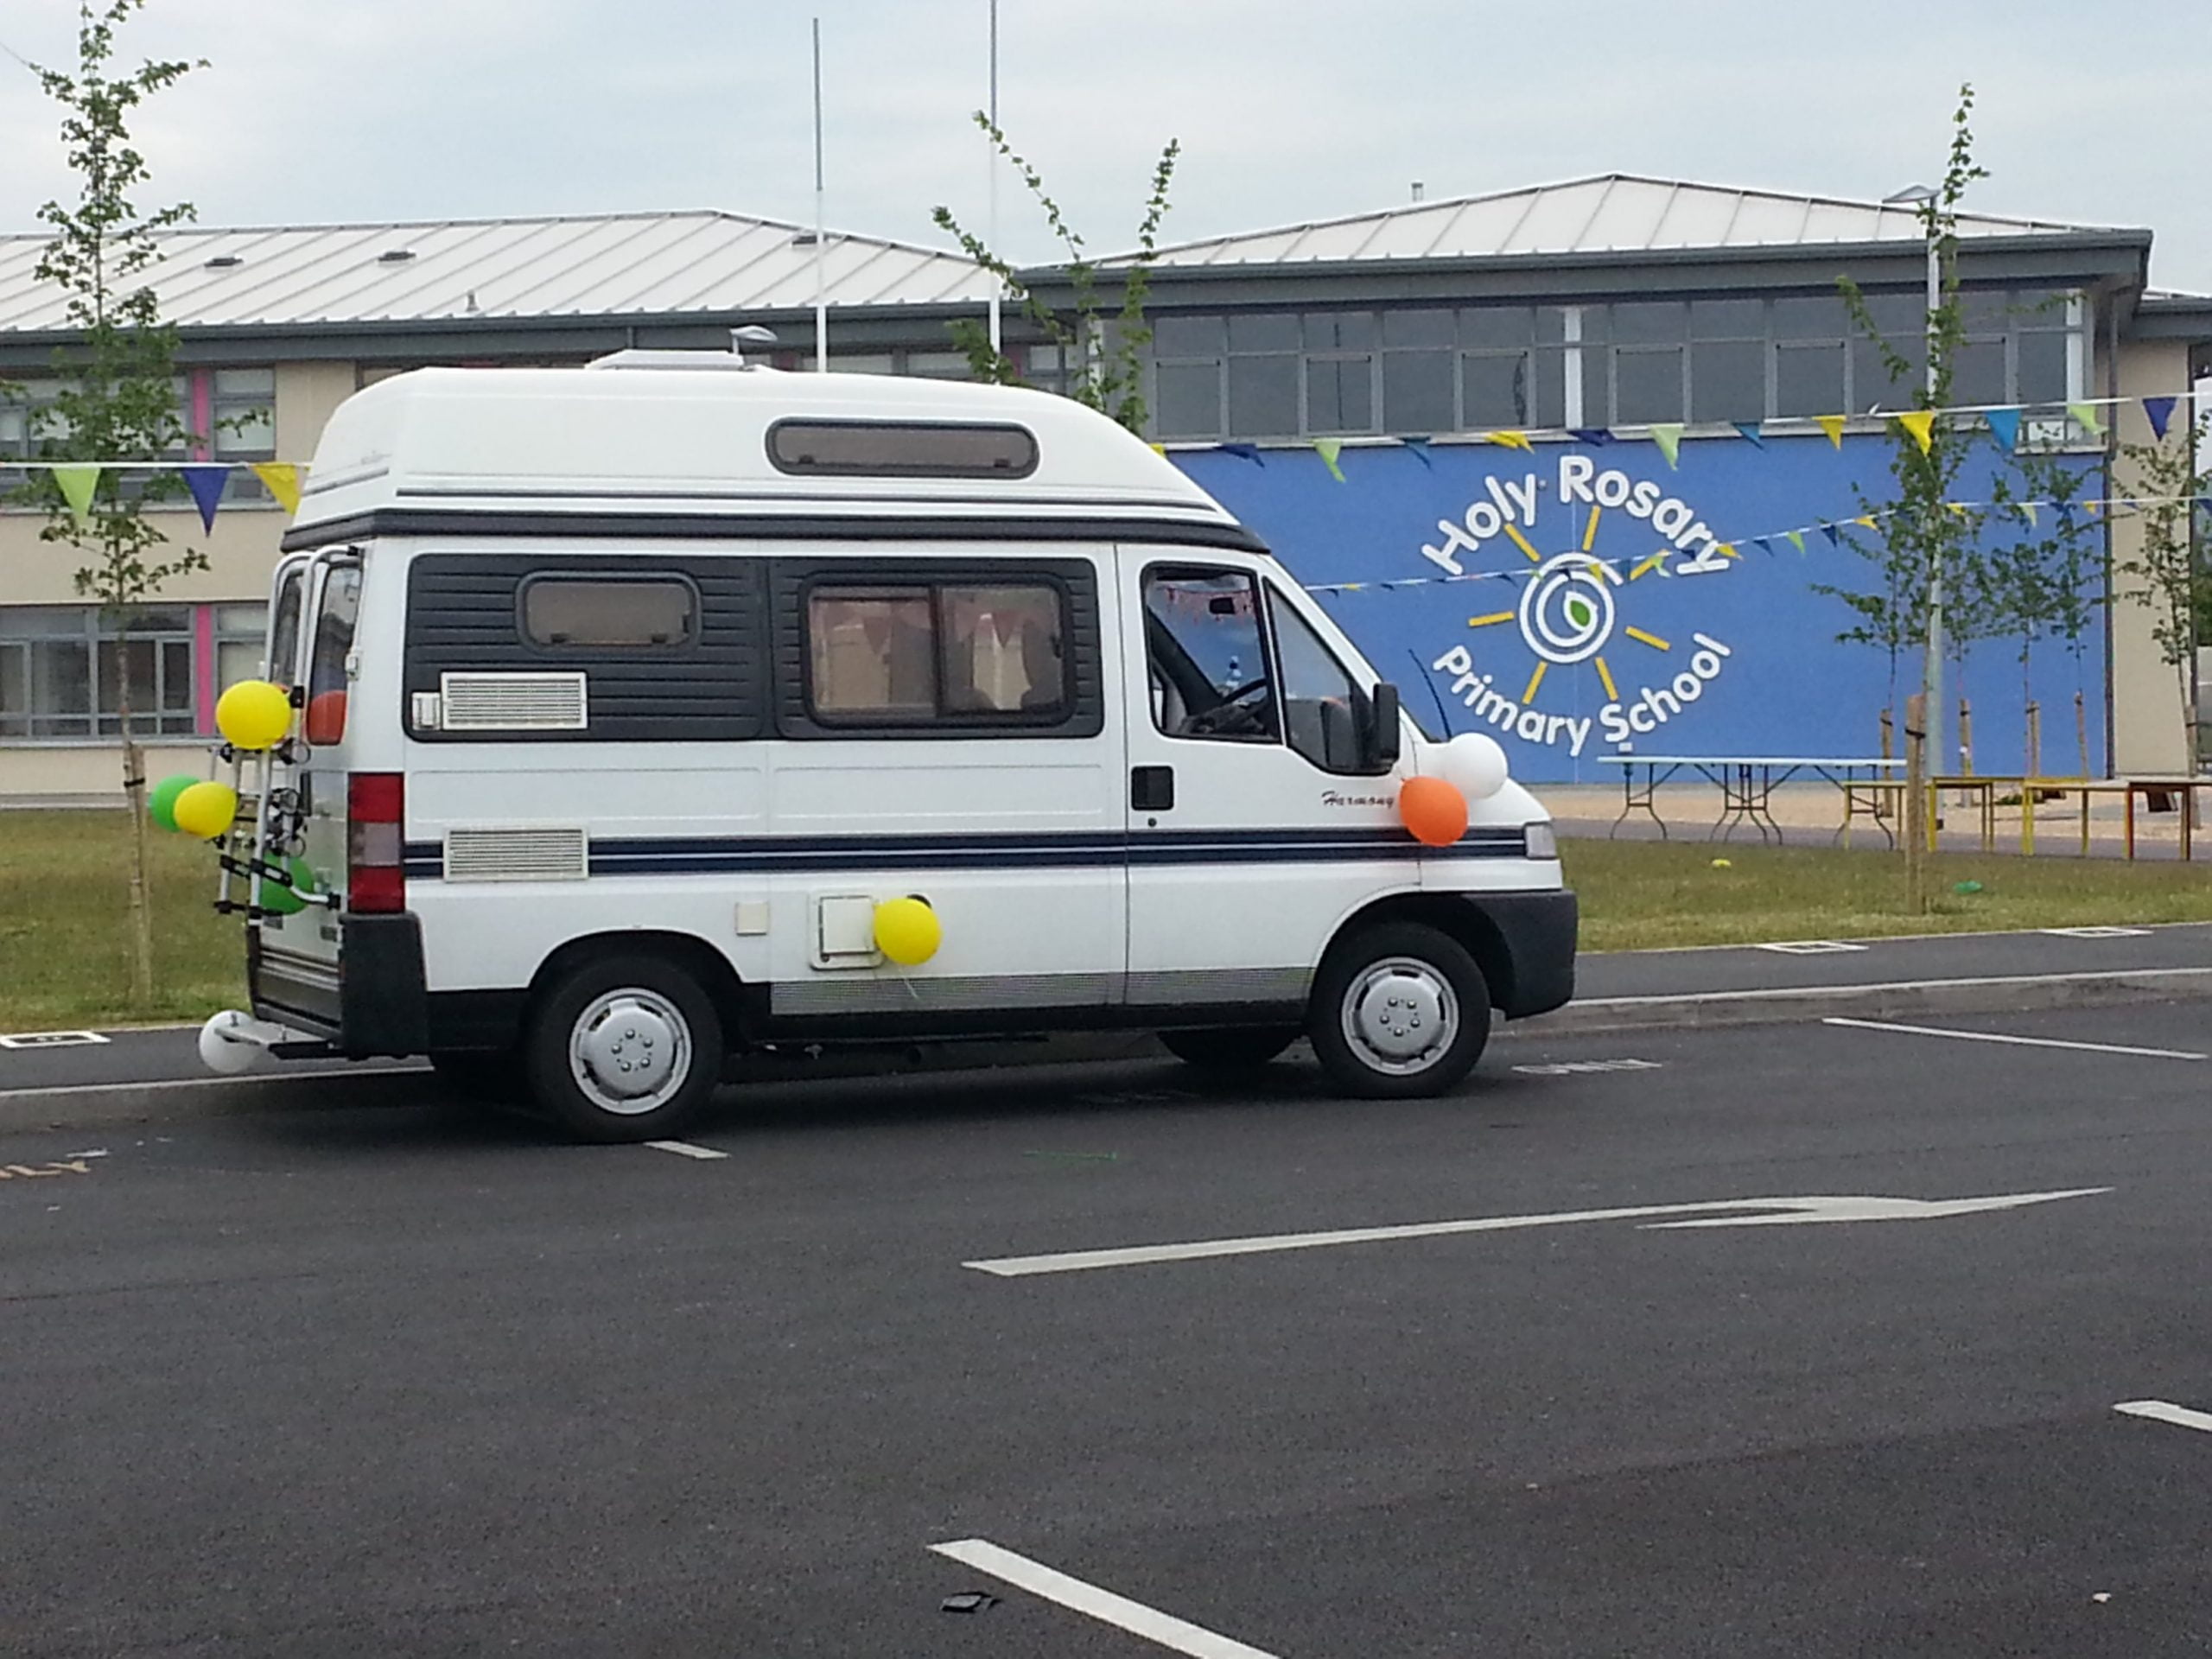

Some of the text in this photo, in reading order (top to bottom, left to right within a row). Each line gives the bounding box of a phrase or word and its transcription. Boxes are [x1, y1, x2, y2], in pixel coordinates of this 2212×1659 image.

[1421, 455, 1730, 575] Holy Rosary
[1433, 632, 1732, 757] Primary School
